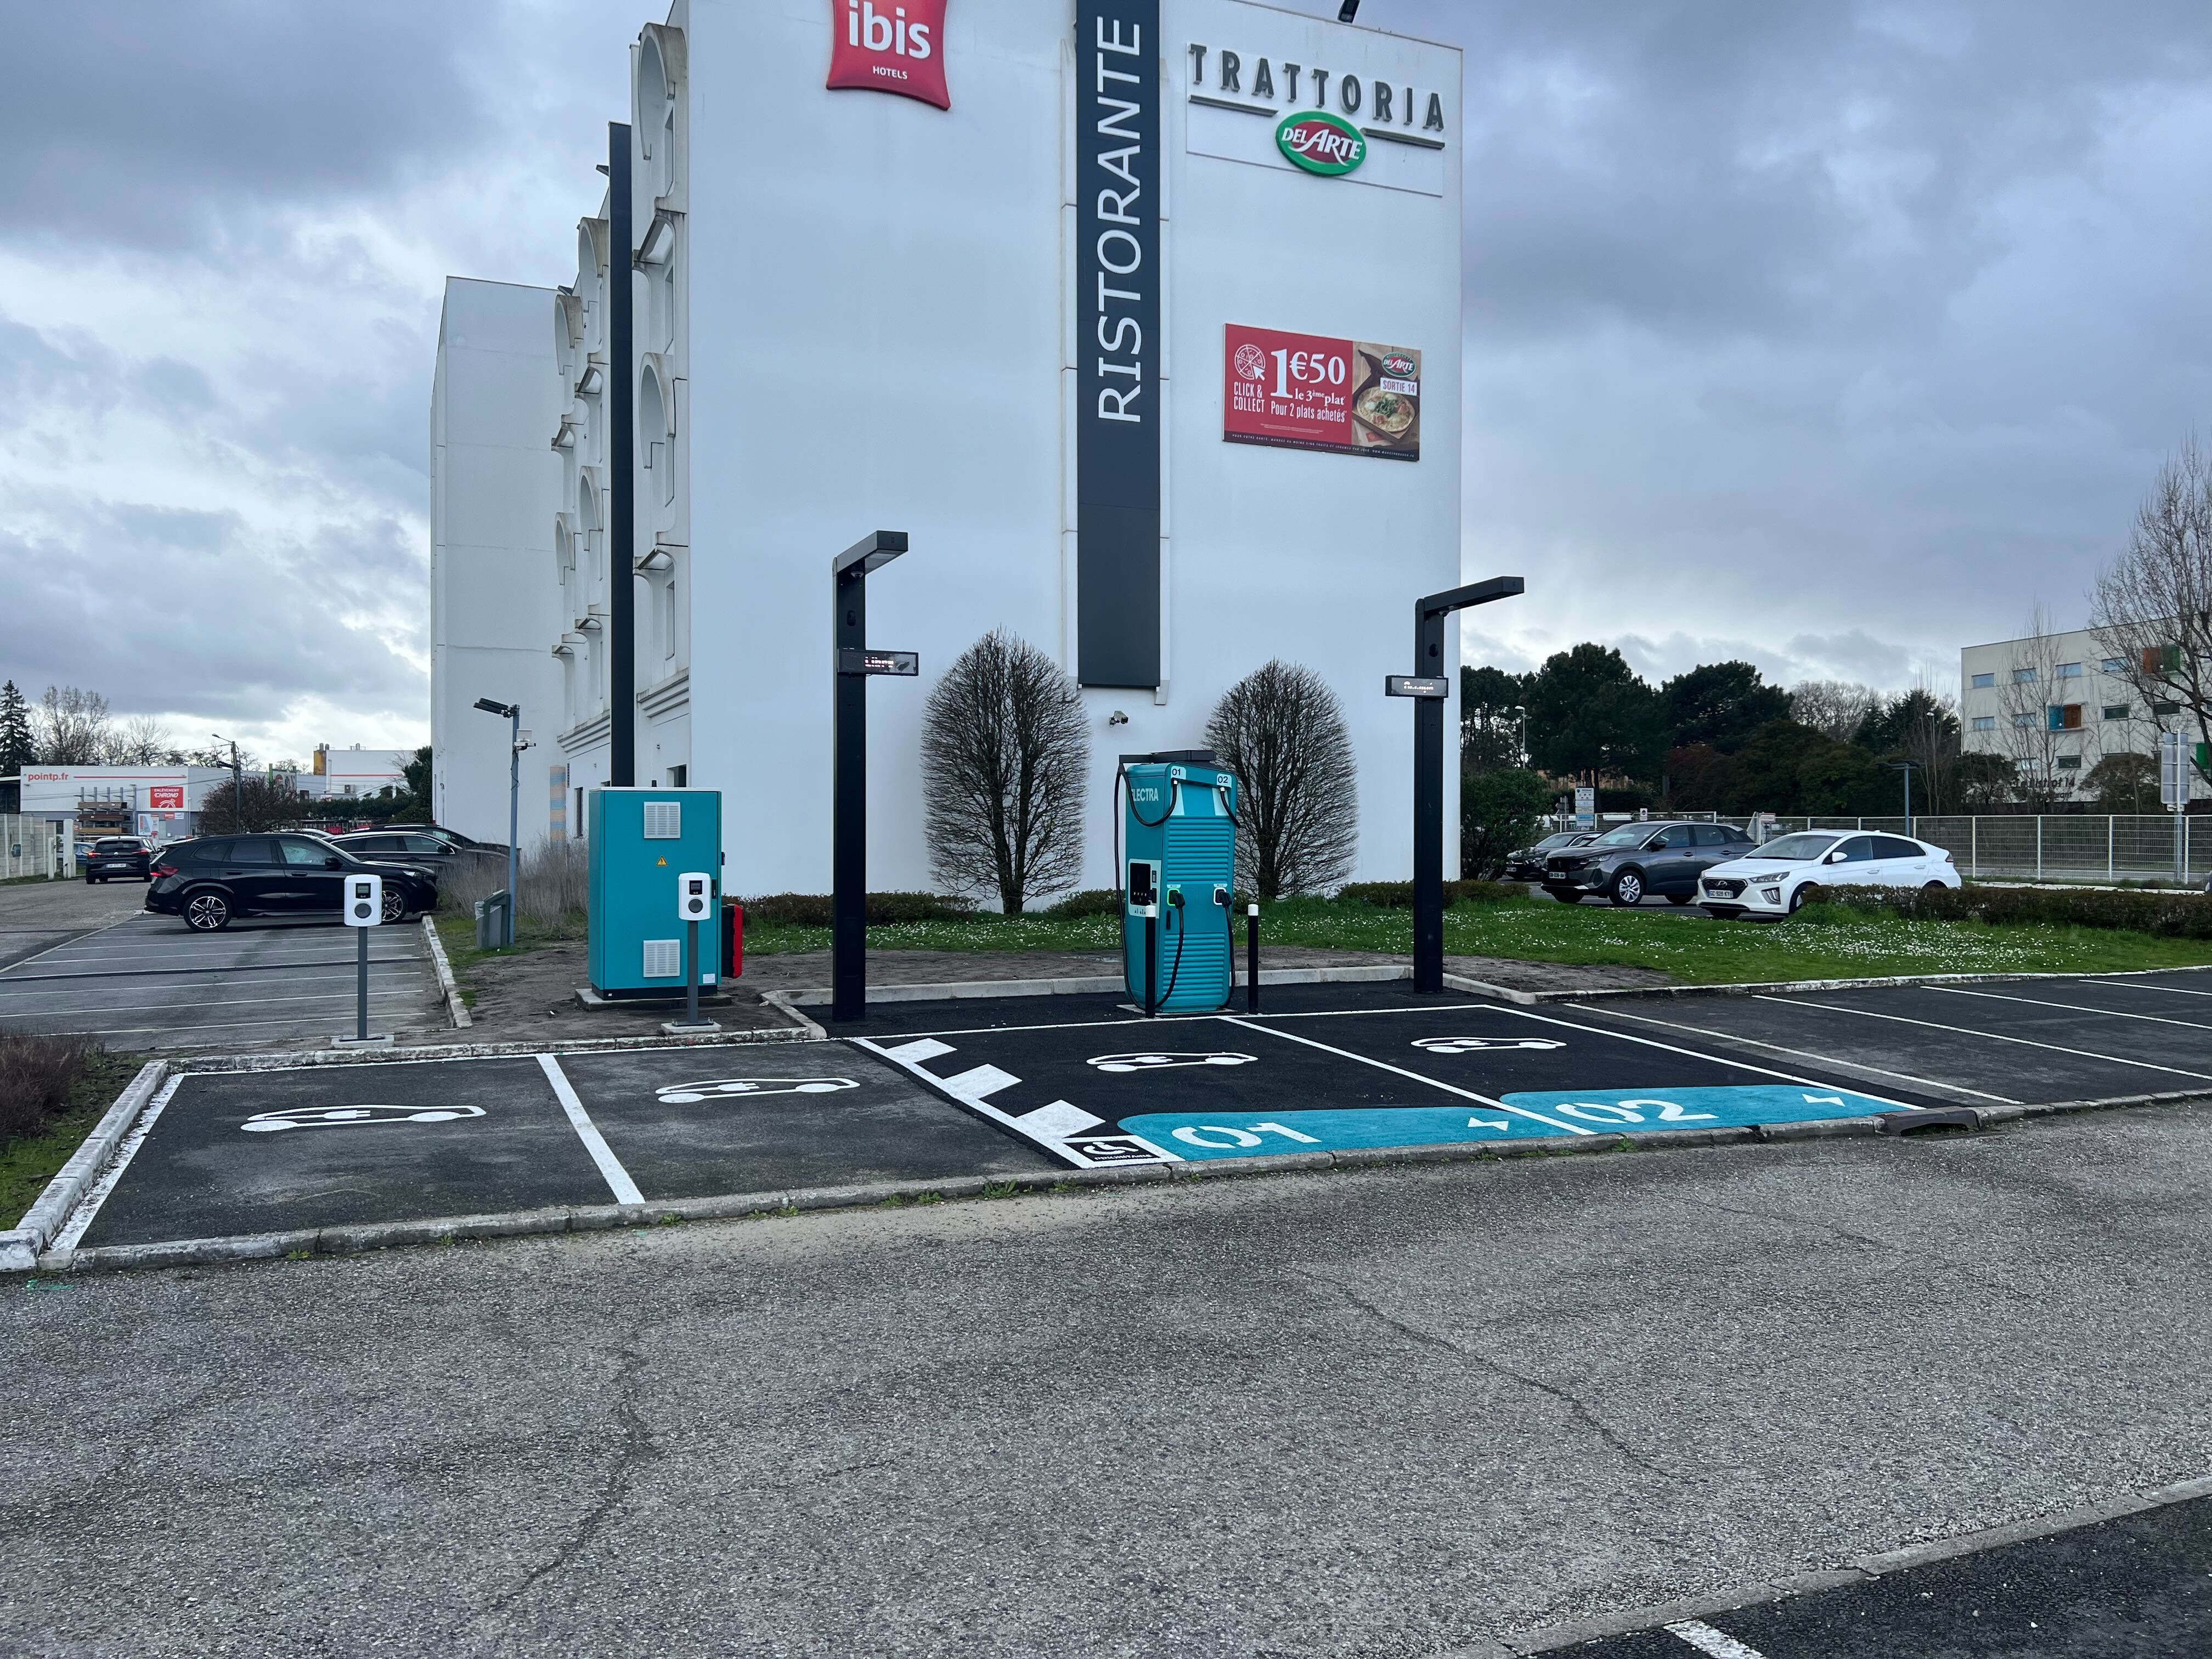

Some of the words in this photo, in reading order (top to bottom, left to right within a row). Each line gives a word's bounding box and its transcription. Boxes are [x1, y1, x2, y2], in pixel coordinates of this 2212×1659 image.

[849, 0, 932, 59] ibis
[873, 65, 908, 80] HOTELS
[1188, 43, 1445, 132] TRATTORIA
[1282, 127, 1307, 144] DEL
[1288, 128, 1363, 167] ARTE
[1097, 15, 1142, 423] RISTORANTE
[1234, 381, 1255, 397] CLICK
[1257, 384, 1263, 398] &
[1295, 388, 1304, 400] le
[1383, 380, 1405, 392] SORTIE
[1408, 383, 1415, 393] 14
[1234, 396, 1265, 413] COLLECT
[1271, 400, 1288, 416] Pour
[1290, 403, 1295, 417] 2
[1296, 404, 1314, 419] plats
[1317, 407, 1346, 423] achetés
[28, 772, 69, 782] pointp.fr
[1555, 1099, 1719, 1123] 02
[1171, 1121, 1323, 1149] 01
